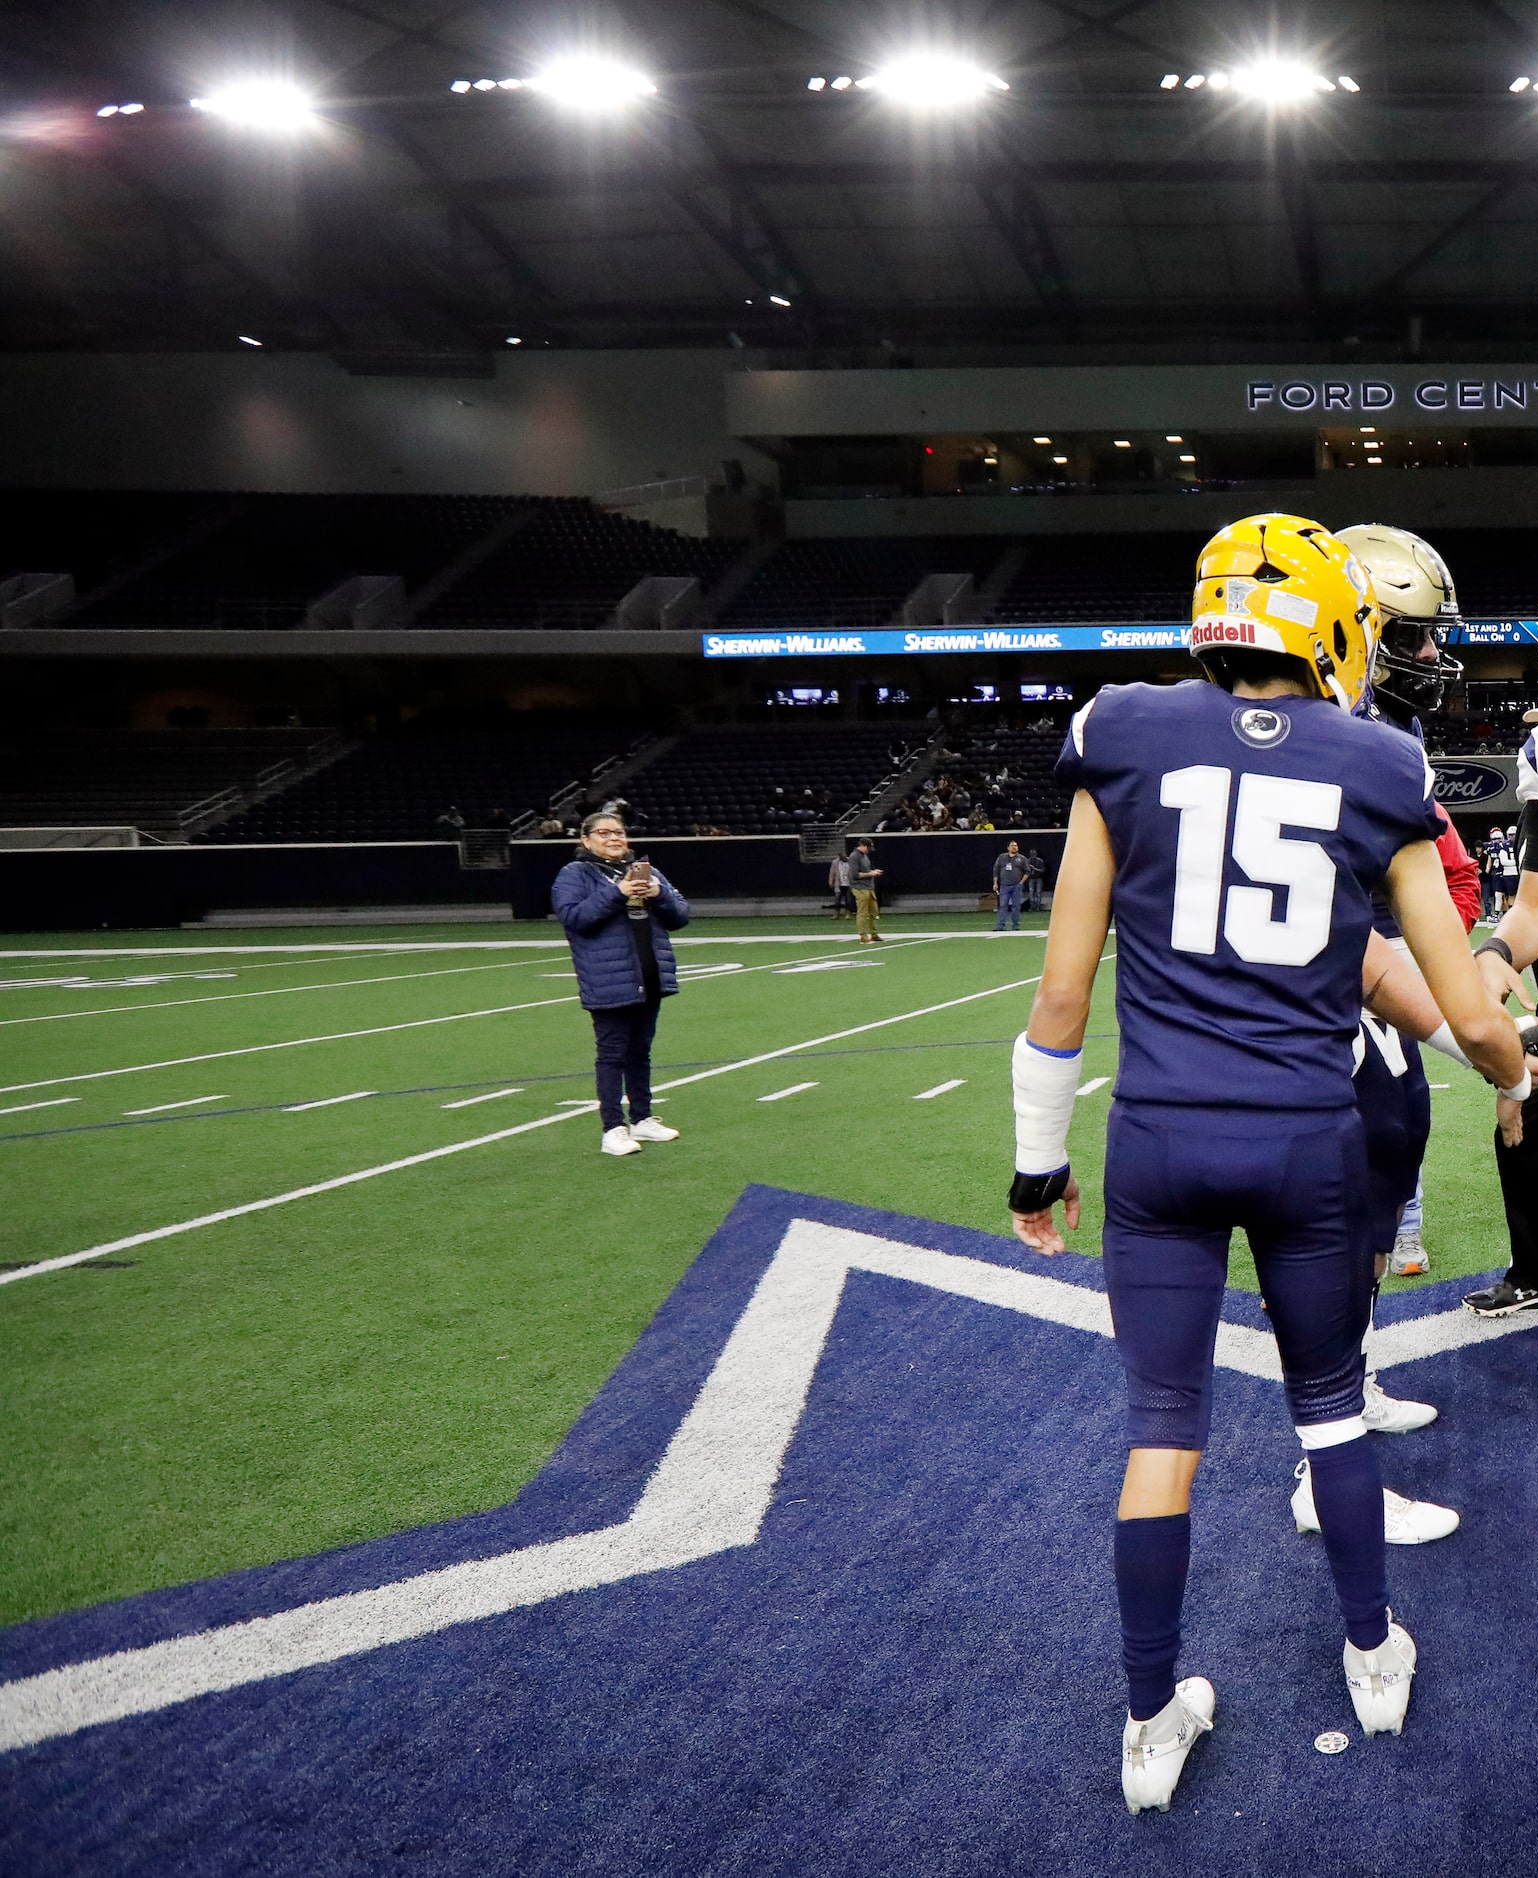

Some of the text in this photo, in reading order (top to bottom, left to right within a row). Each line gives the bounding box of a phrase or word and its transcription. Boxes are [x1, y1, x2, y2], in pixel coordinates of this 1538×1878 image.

[1247, 381, 1395, 411] FORD
[1481, 624, 1498, 632] AND
[1500, 623, 1512, 633] 10
[1433, 768, 1484, 797] Ford
[1160, 764, 1343, 967] 15
